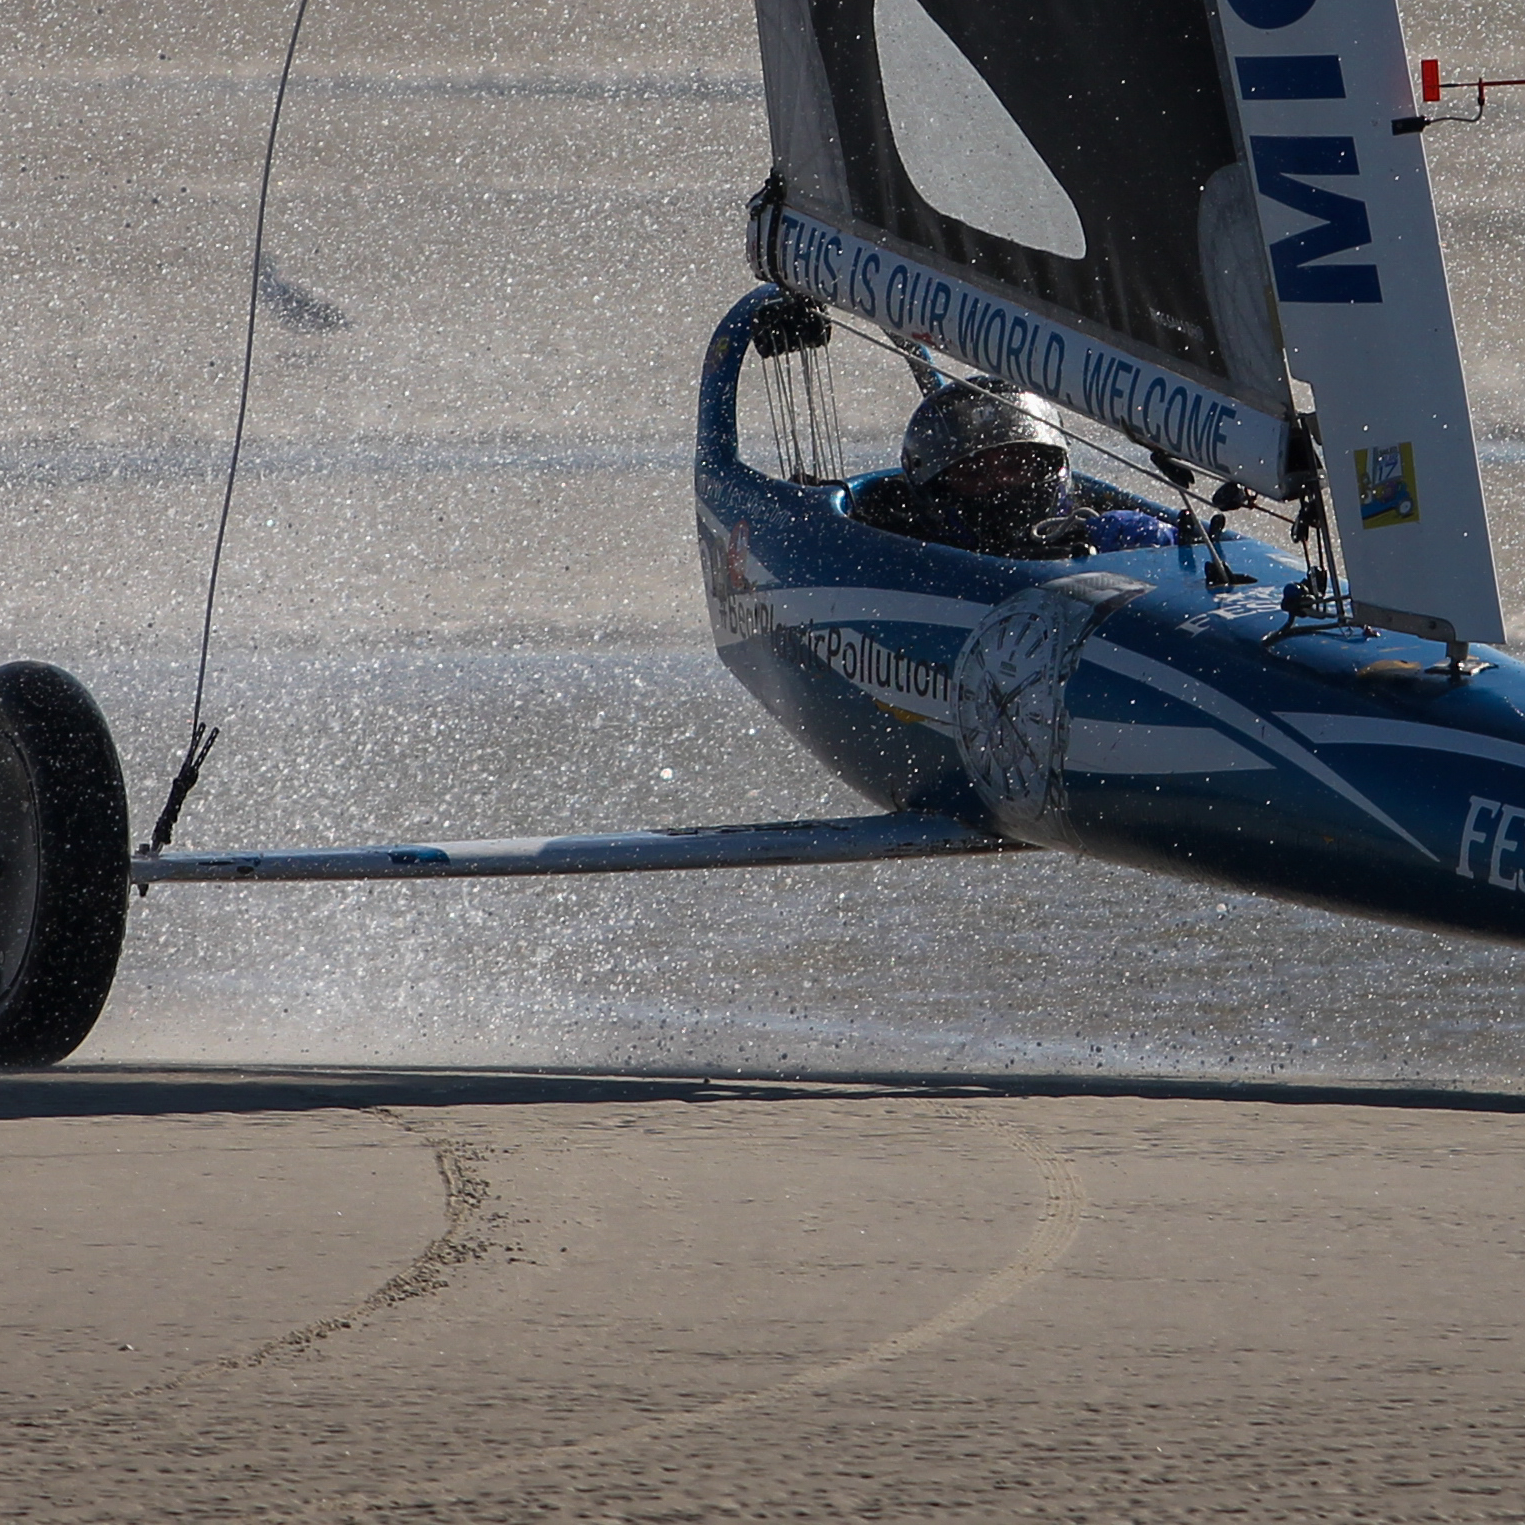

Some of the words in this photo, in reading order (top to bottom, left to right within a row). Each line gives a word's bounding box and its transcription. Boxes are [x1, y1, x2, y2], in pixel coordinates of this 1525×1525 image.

[781, 214, 843, 304] THIS
[849, 246, 881, 318] IS
[886, 263, 951, 350] OUR
[1082, 347, 1237, 472] WELCOME
